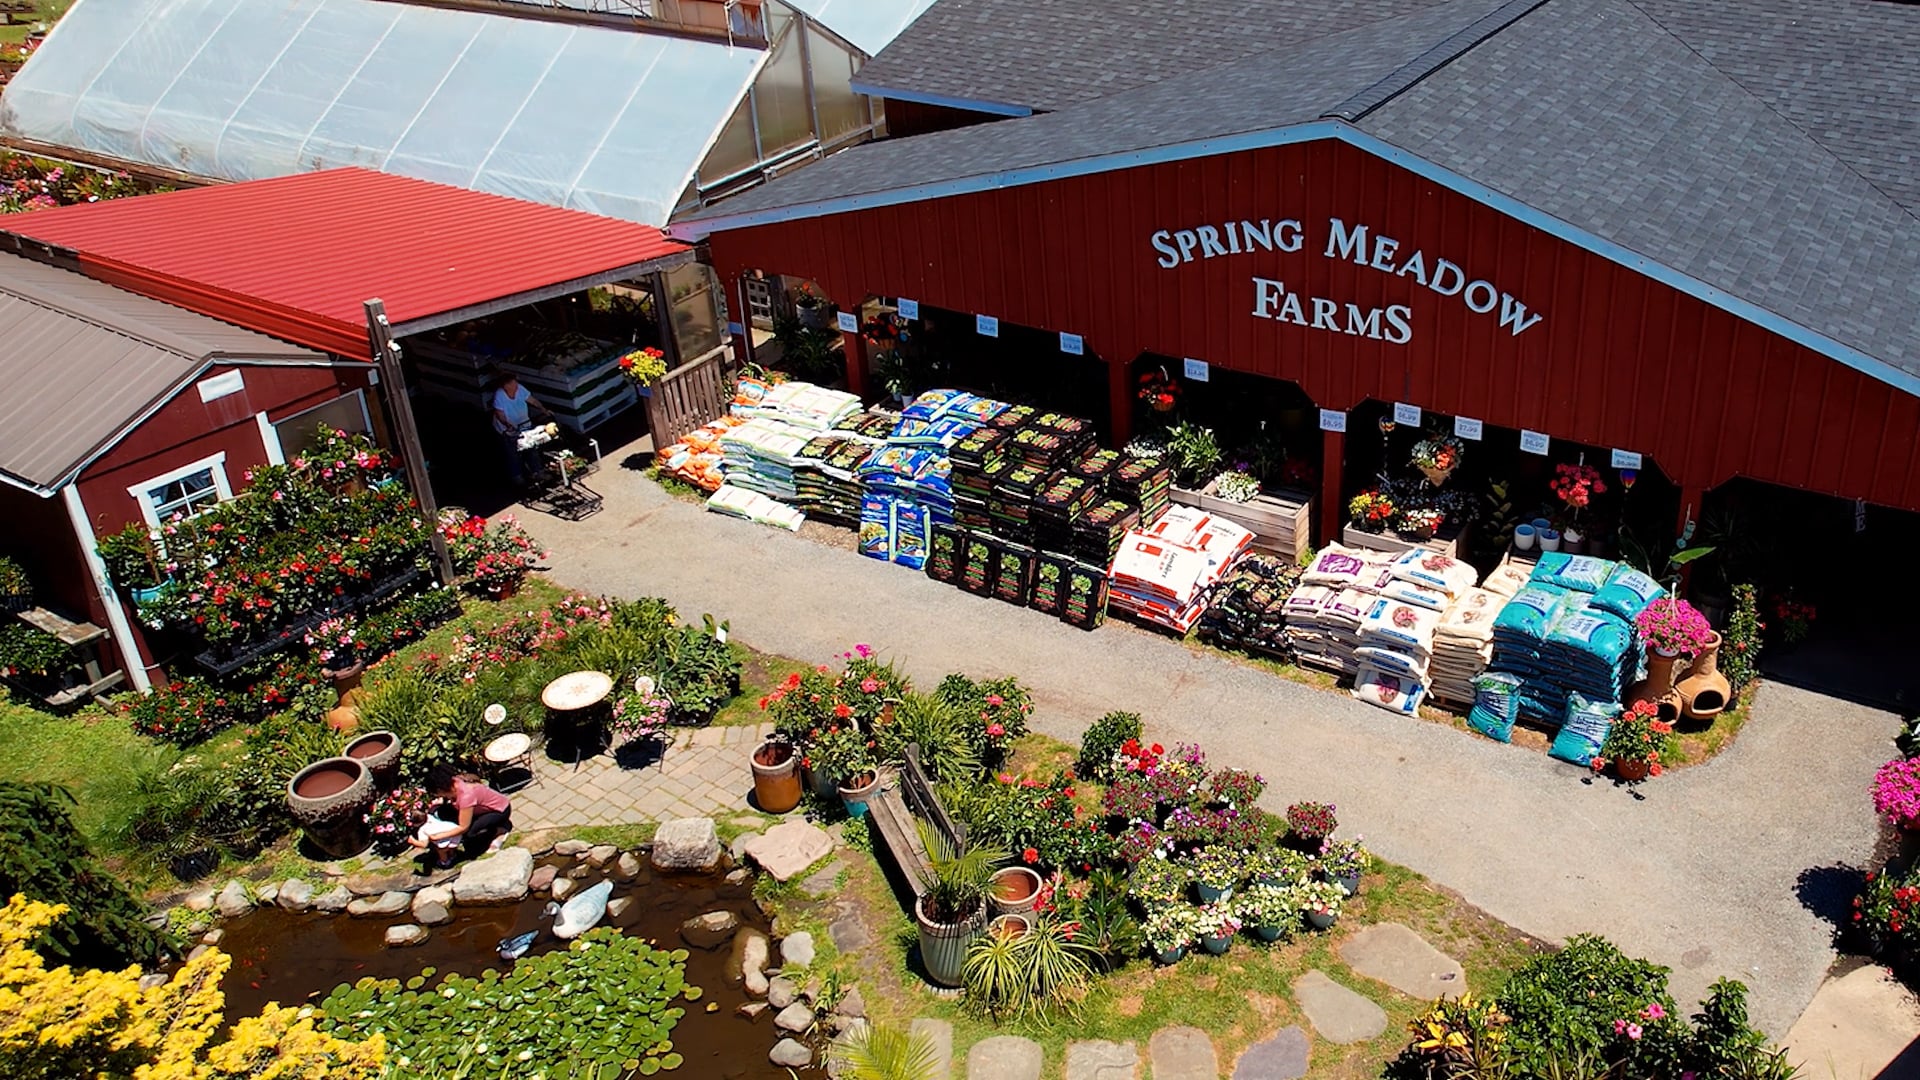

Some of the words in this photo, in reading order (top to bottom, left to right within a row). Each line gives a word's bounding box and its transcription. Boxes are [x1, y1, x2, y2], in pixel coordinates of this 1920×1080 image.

[1151, 219, 1304, 269] SPRING
[1323, 217, 1543, 337] MEADOW
[1251, 276, 1413, 345] FARMS
